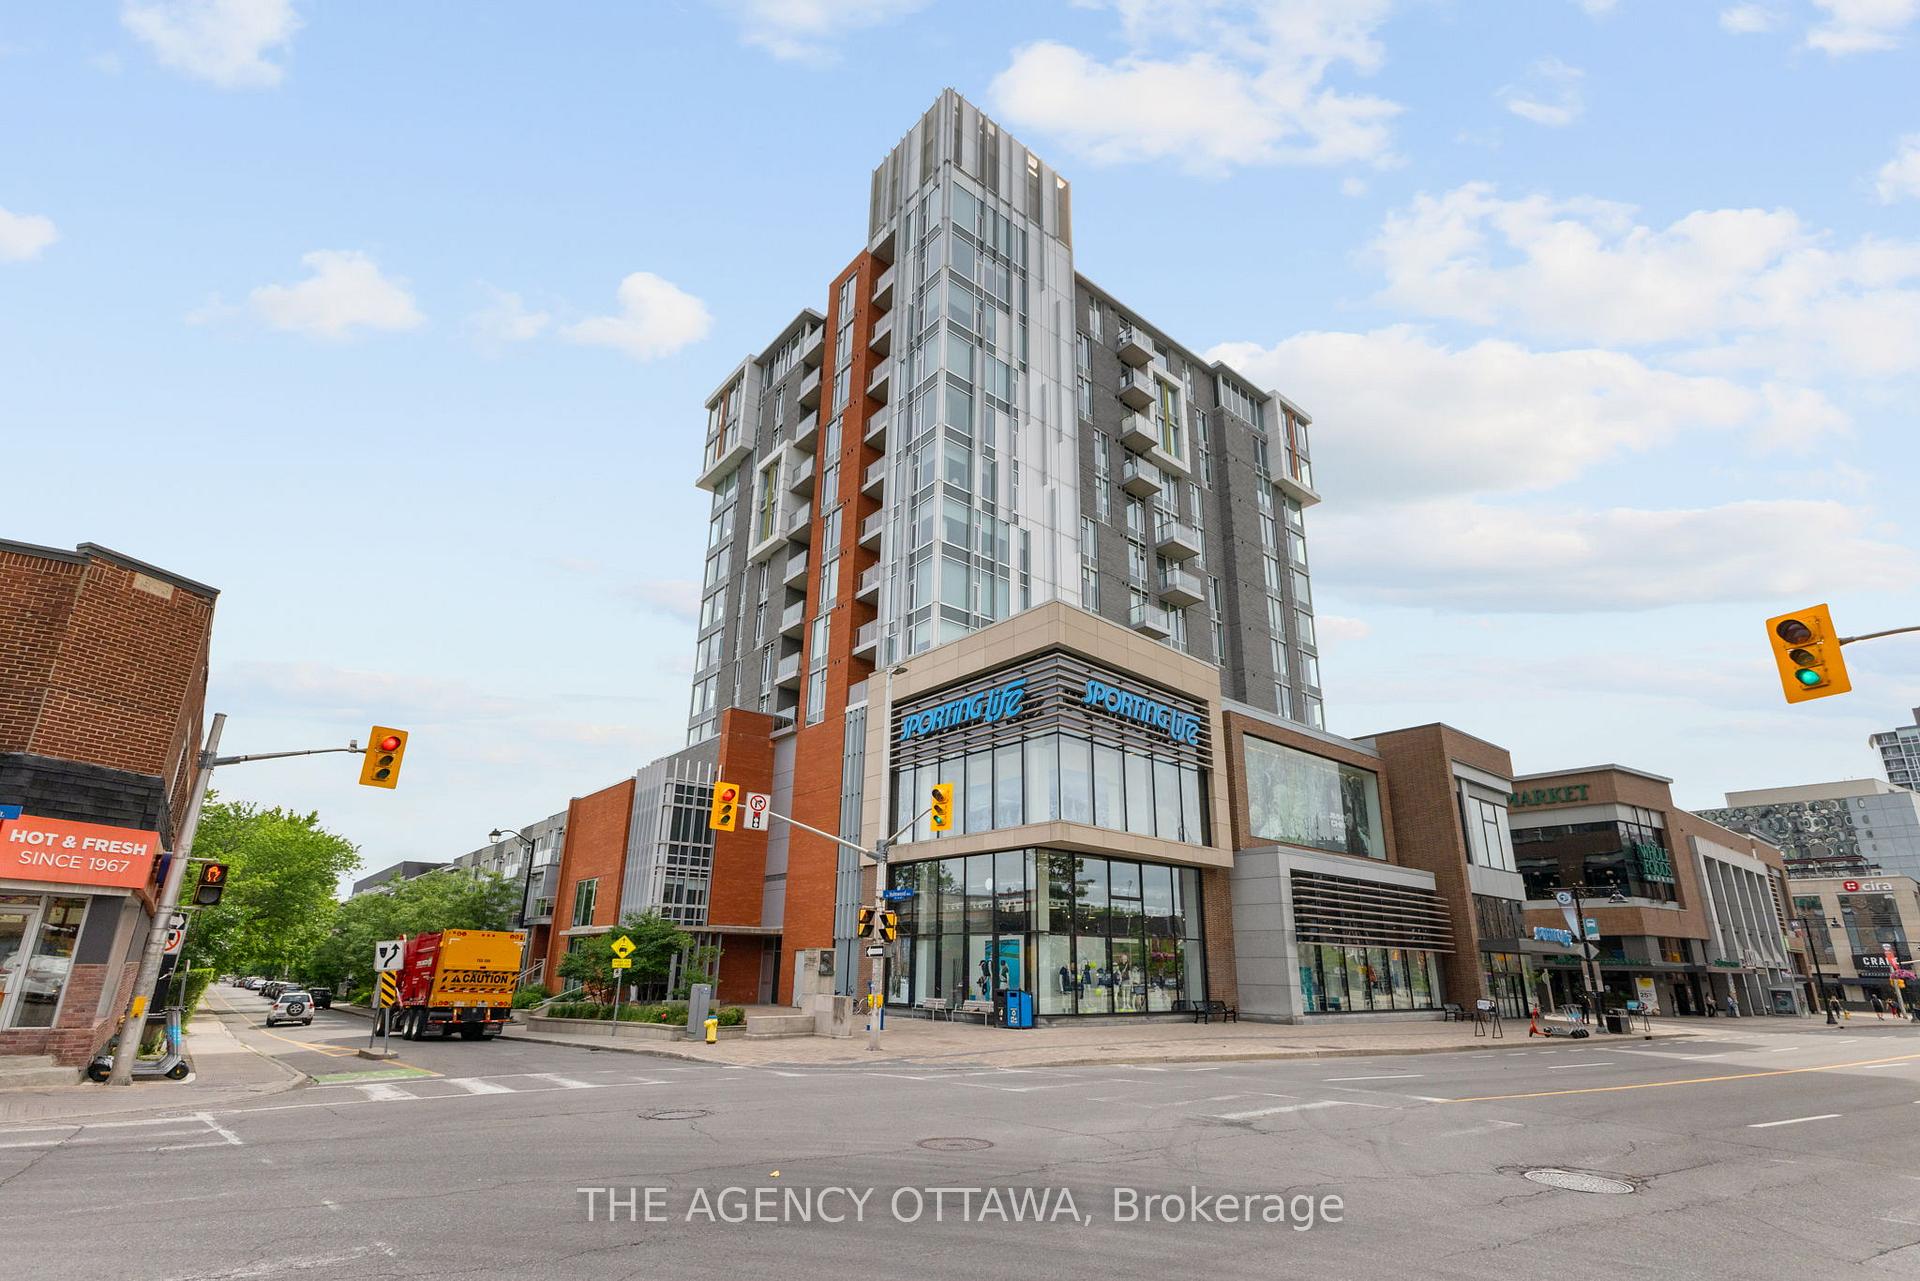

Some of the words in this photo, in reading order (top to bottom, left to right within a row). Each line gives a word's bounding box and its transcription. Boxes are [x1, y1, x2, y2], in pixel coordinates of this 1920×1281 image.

[9, 829, 59, 846] HOT
[61, 835, 77, 849] &
[81, 837, 148, 857] FRESH
[18, 850, 84, 869] SINCE
[89, 857, 131, 873] 1967
[1862, 880, 1893, 891] cira
[462, 974, 509, 984] CAUTION
